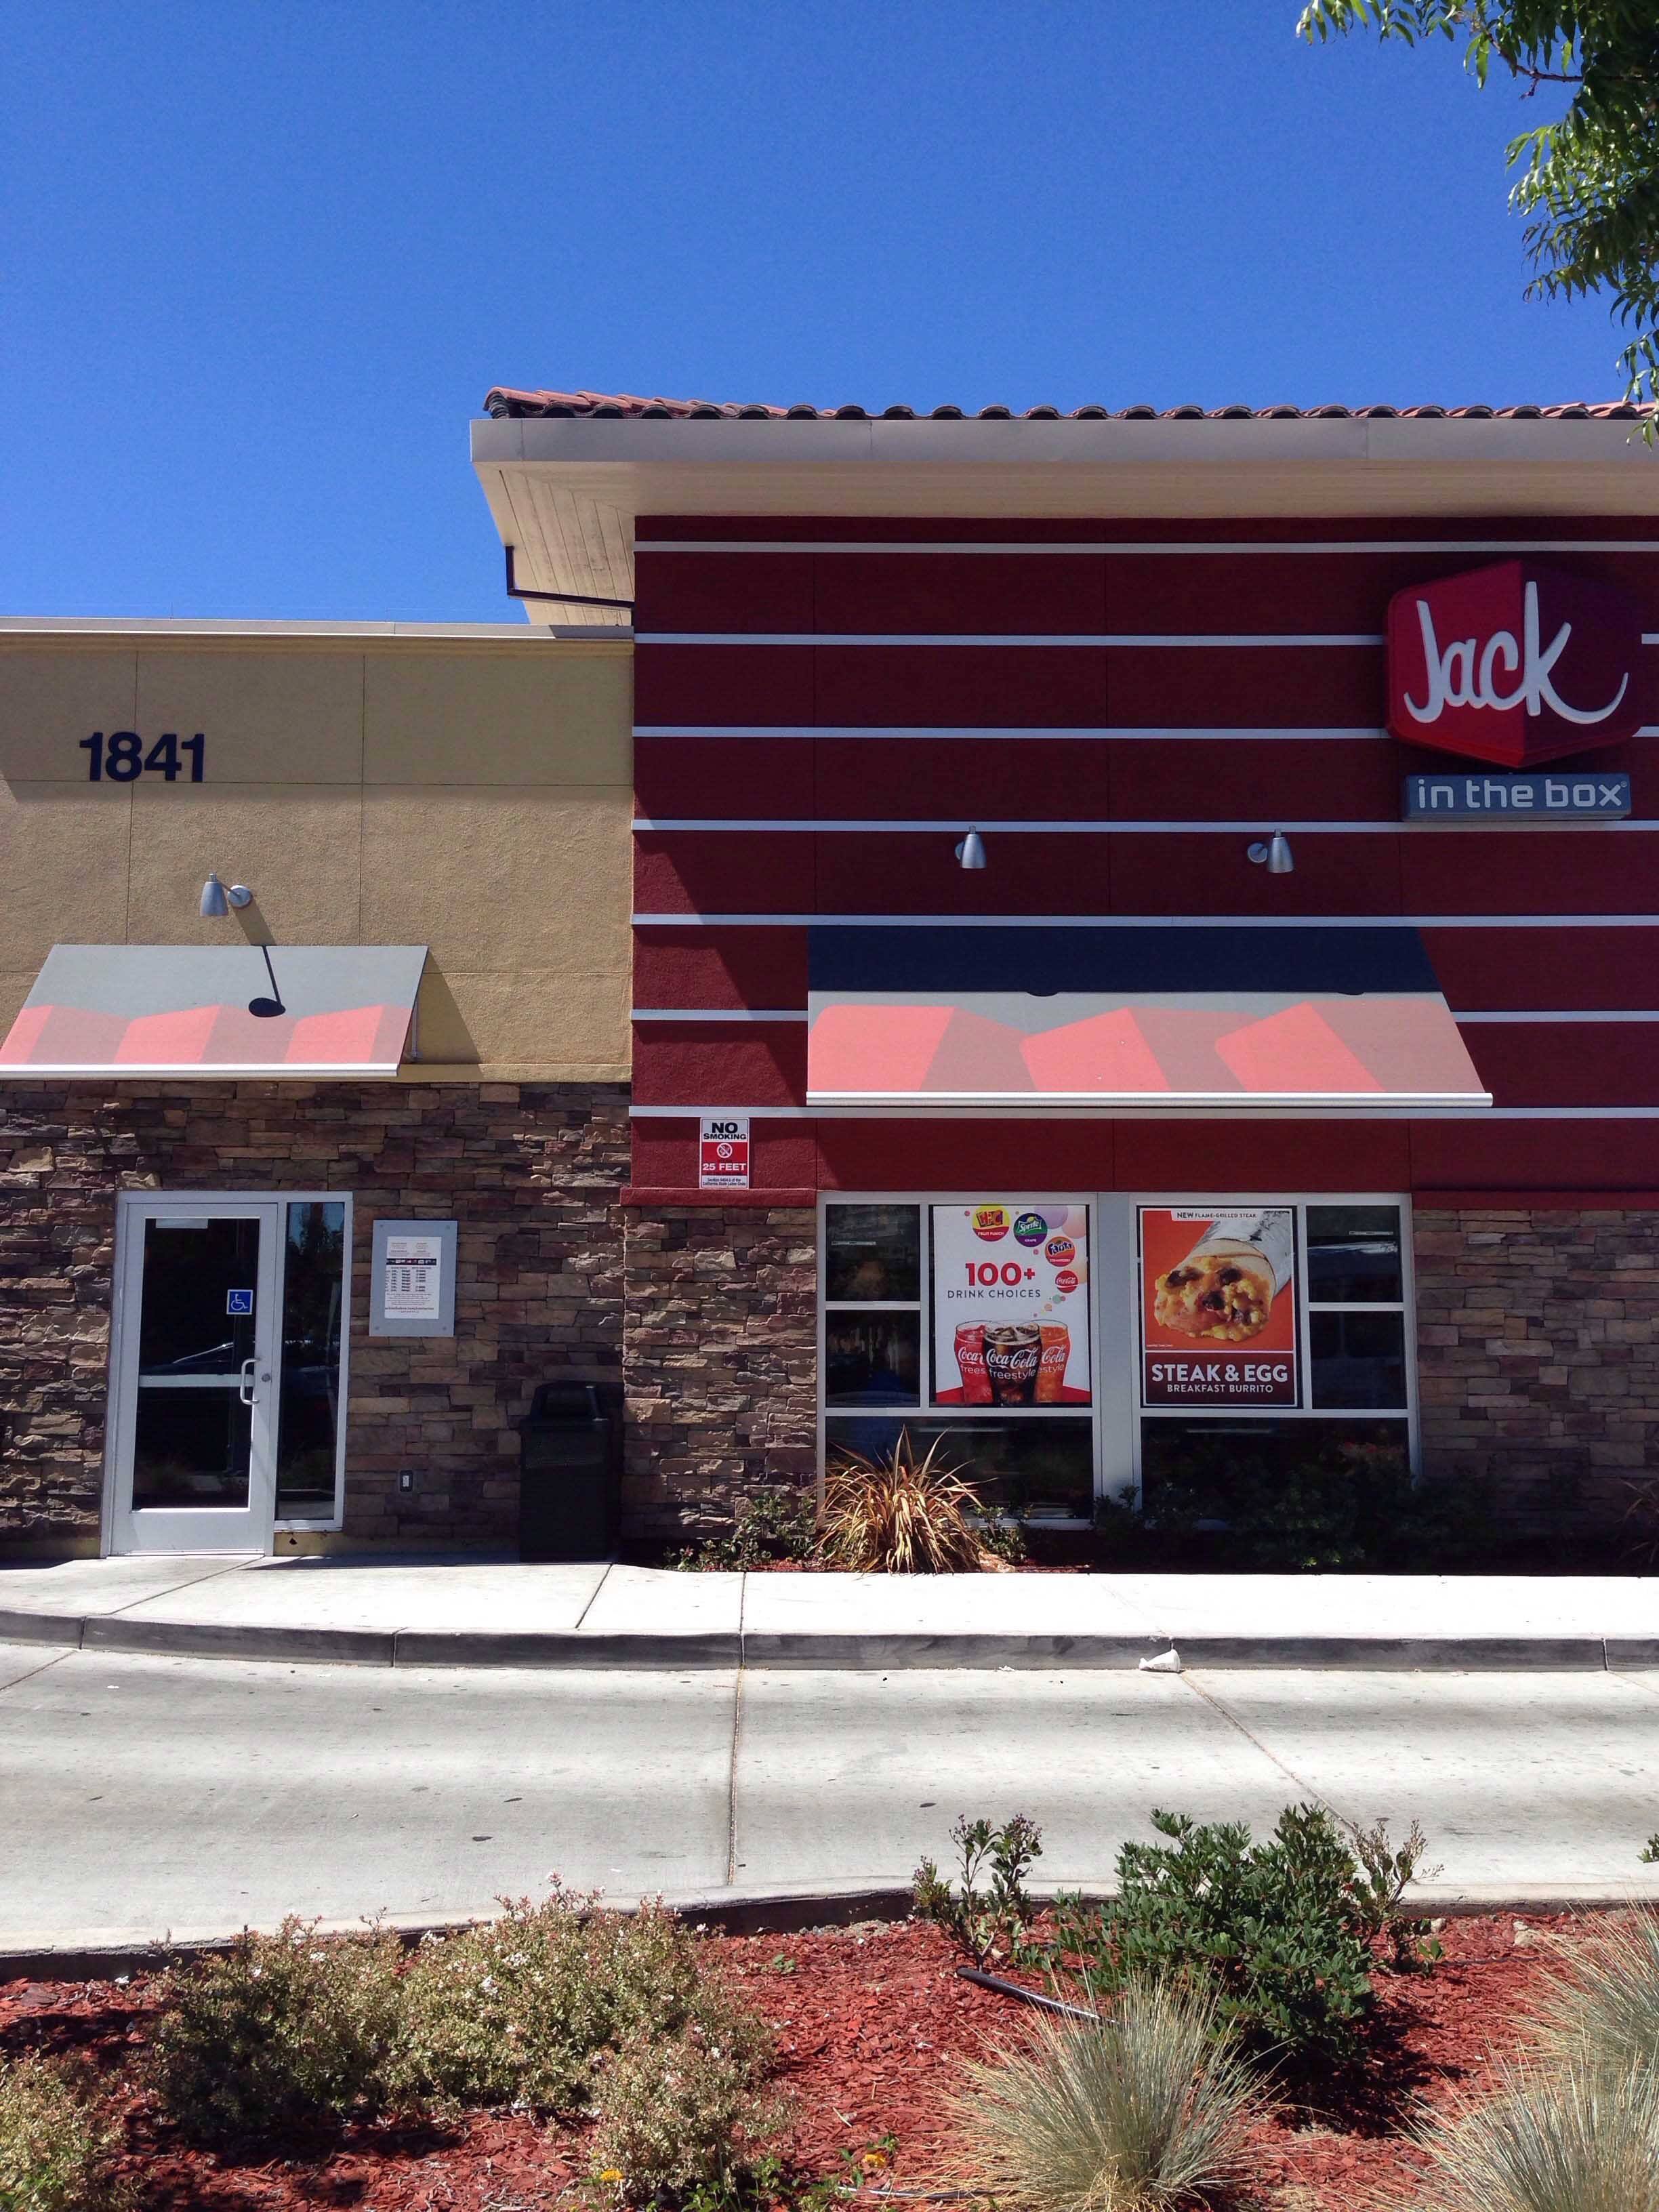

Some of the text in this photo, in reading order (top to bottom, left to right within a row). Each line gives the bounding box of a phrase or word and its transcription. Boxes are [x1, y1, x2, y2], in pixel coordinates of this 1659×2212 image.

[1404, 581, 1629, 724] Jack
[79, 732, 205, 782] 1841
[1418, 779, 1622, 808] in the box
[712, 1122, 738, 1133] NO
[702, 1163, 747, 1171] 25 FEET
[1019, 1220, 1040, 1232] Sprite
[1048, 1242, 1074, 1255] Fanta
[965, 1262, 1036, 1286] 100+
[947, 1289, 1041, 1298] DRINK CHOICES
[986, 1347, 1039, 1370] Coca-Cola
[961, 1364, 986, 1374] frees
[989, 1367, 1036, 1380] freestyle
[1151, 1364, 1288, 1382] STEAK & EGG
[1167, 1385, 1273, 1393] BREAKFAST BURRITO
